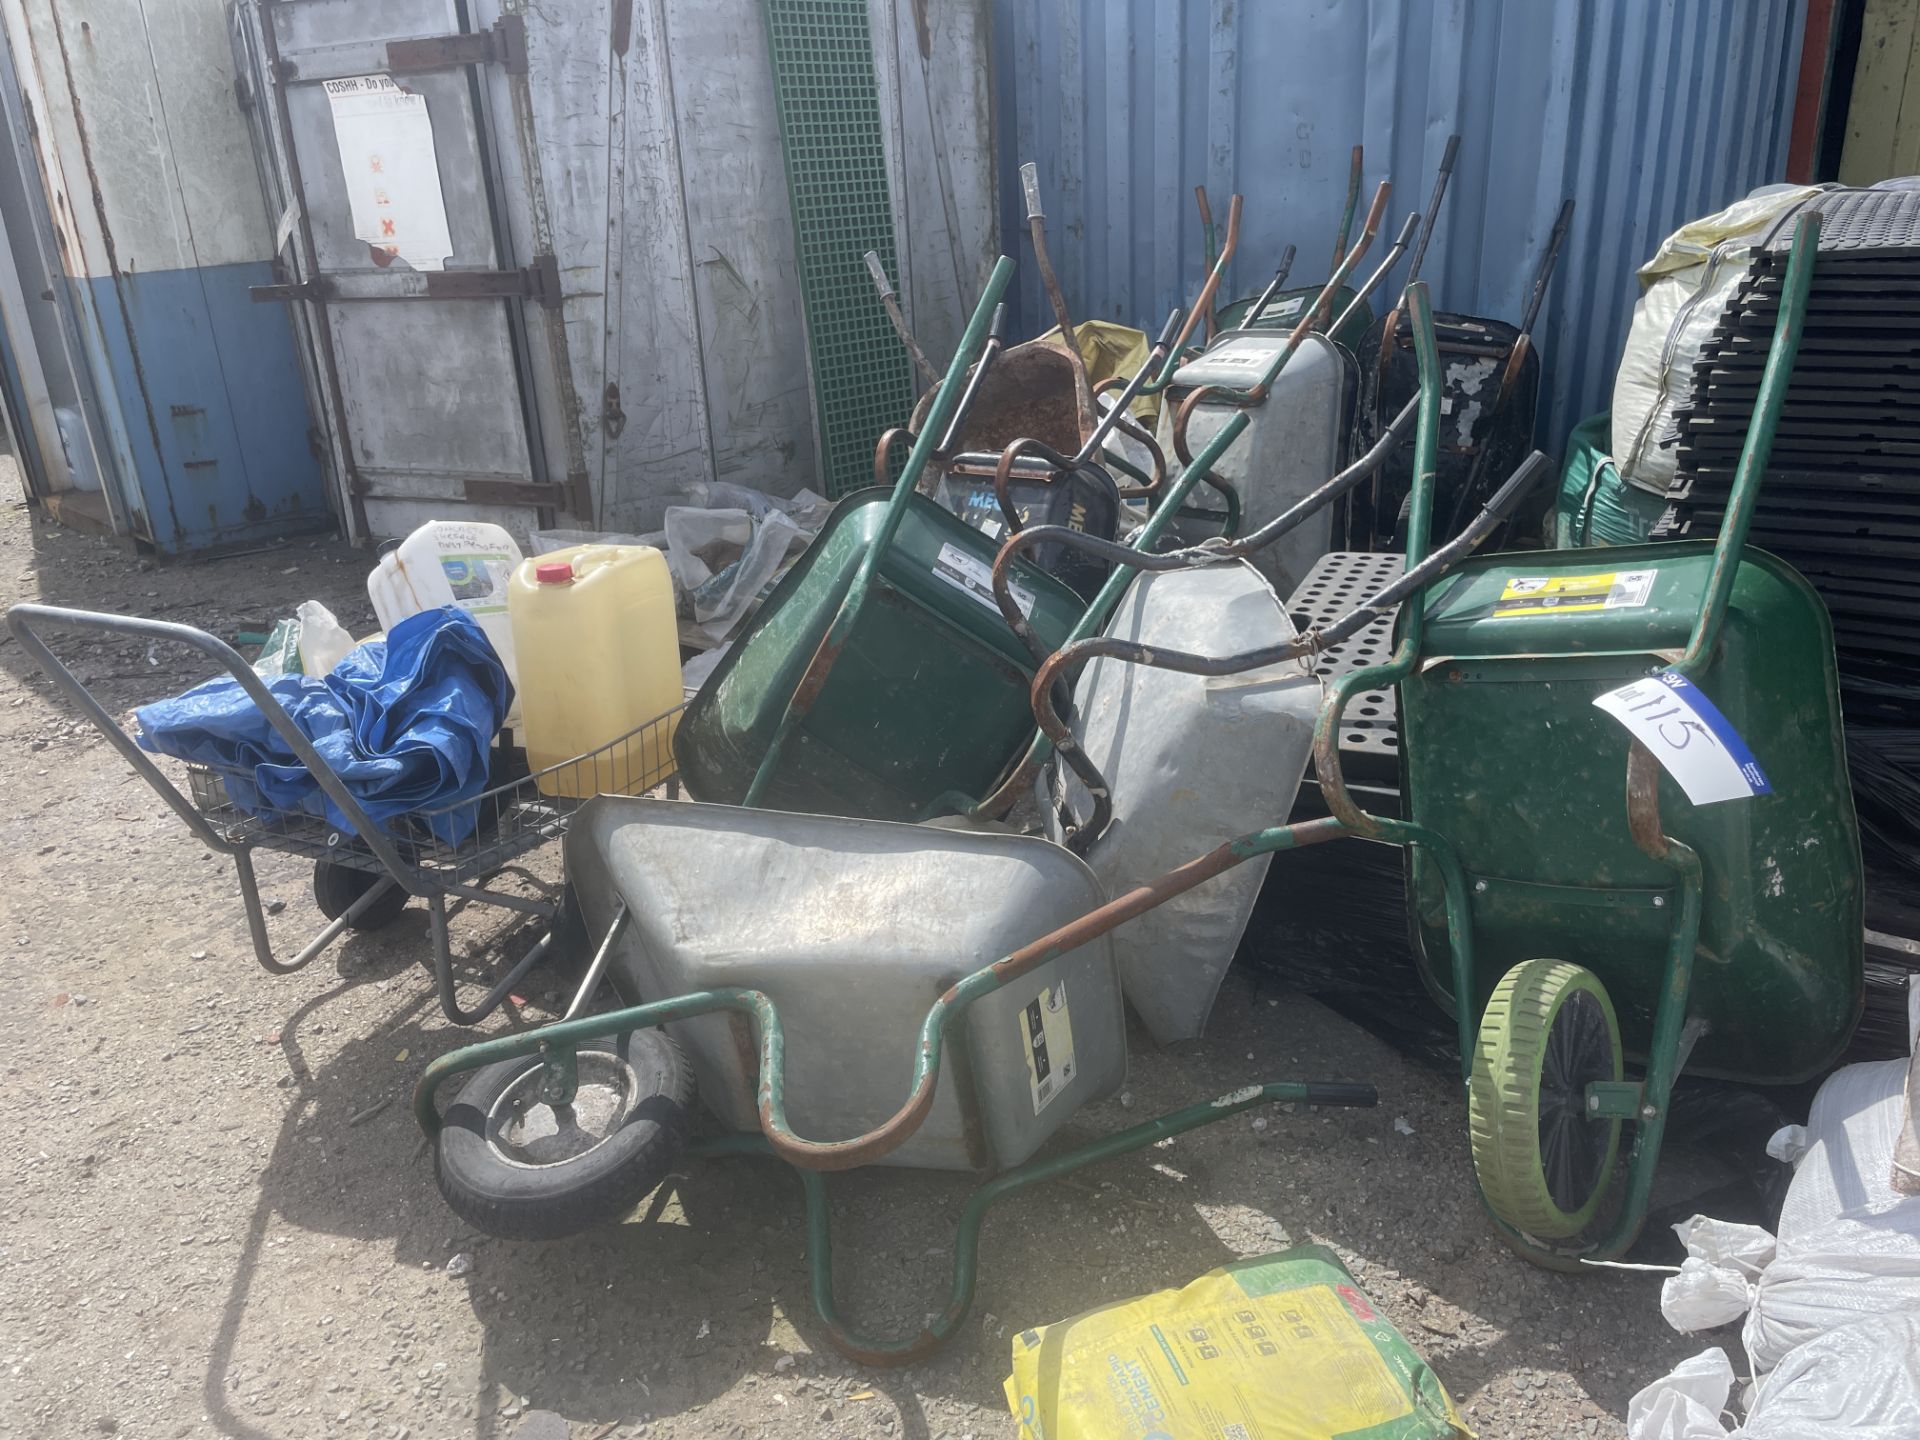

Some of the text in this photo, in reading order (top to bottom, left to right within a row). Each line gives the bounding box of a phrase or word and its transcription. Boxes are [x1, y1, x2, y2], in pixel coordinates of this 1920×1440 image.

[326, 80, 358, 94] COSHH
[366, 79, 378, 89] Do
[1628, 693, 1716, 750] 115
[1122, 1359, 1166, 1423] CEMENT
